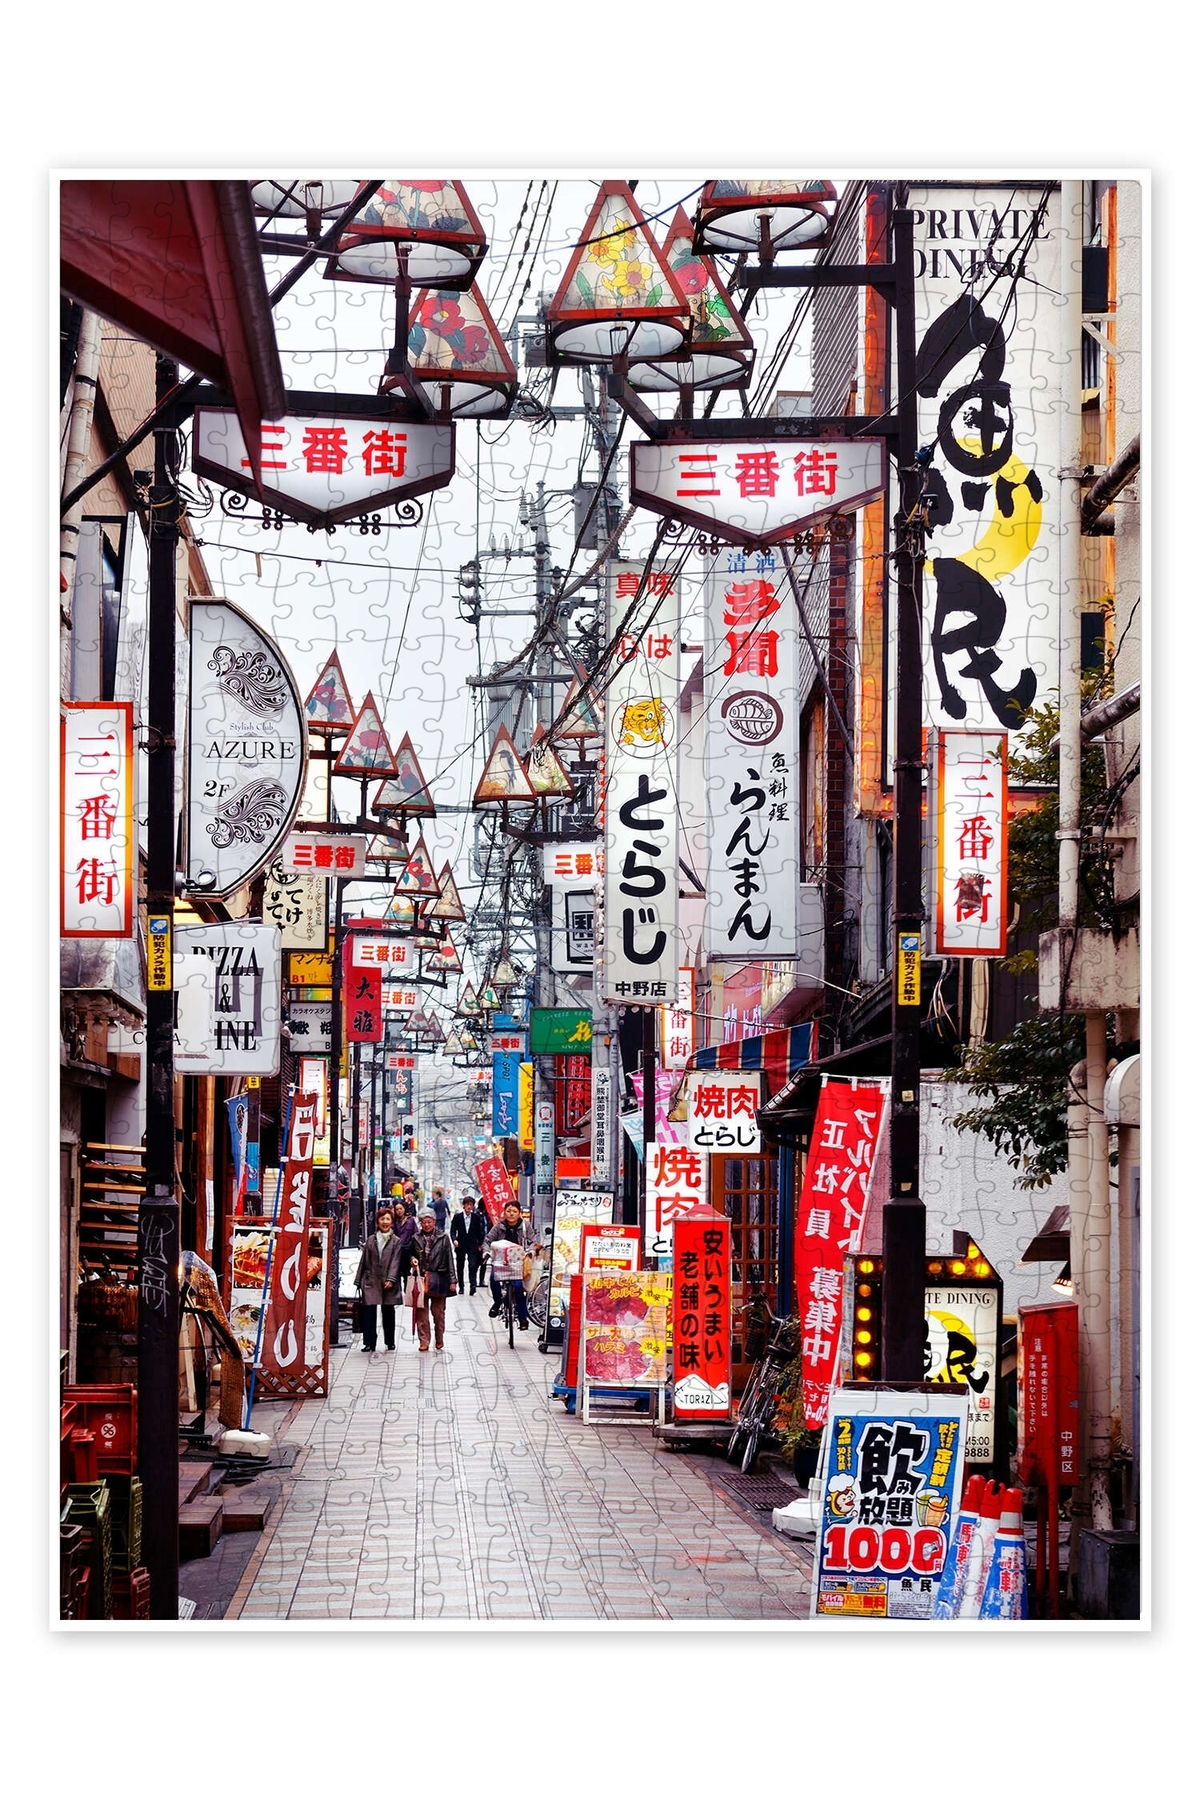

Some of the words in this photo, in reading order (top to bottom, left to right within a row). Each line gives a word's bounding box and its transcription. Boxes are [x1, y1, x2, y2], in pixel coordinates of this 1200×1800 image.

[913, 208, 1050, 240] PRIVATE
[241, 424, 408, 478] 三番街
[676, 449, 839, 499] 三番街
[916, 294, 1043, 731] 魚民
[229, 721, 254, 733] Stylish
[255, 721, 275, 733] Club
[205, 740, 296, 760] AZURE
[203, 779, 232, 798] 2F
[768, 751, 790, 822] 魚料理
[74, 733, 118, 906] 三番街
[293, 844, 356, 869] 三番街
[725, 767, 772, 942] らんまん
[954, 758, 996, 924] 三番街
[618, 773, 668, 965] とらじ
[153, 934, 166, 987] 防犯カメラ作動中
[360, 945, 406, 963] 三番街
[292, 975, 305, 983] B1
[615, 981, 667, 997] 中野店
[903, 951, 916, 1002] 防犯カメラ作動中
[219, 983, 232, 1014] &
[382, 991, 416, 1006] 三番街
[214, 1020, 257, 1051] INE
[670, 982, 688, 1058] 三番街
[490, 1037, 520, 1049] 三番街
[389, 1057, 415, 1067] 三番街
[693, 1084, 760, 1120] 焼肉
[694, 1125, 757, 1147] とらじ
[653, 1145, 703, 1233] 焼肉
[651, 1235, 673, 1254] と
[703, 1229, 725, 1362] 安いうまい
[947, 1292, 991, 1305] DINING
[680, 1251, 700, 1372] 老舗の味
[684, 1394, 714, 1405] TORAZI
[1061, 1430, 1074, 1473] 中野区
[858, 1497, 915, 1527] 放題
[901, 1578, 932, 1593] 魚民
